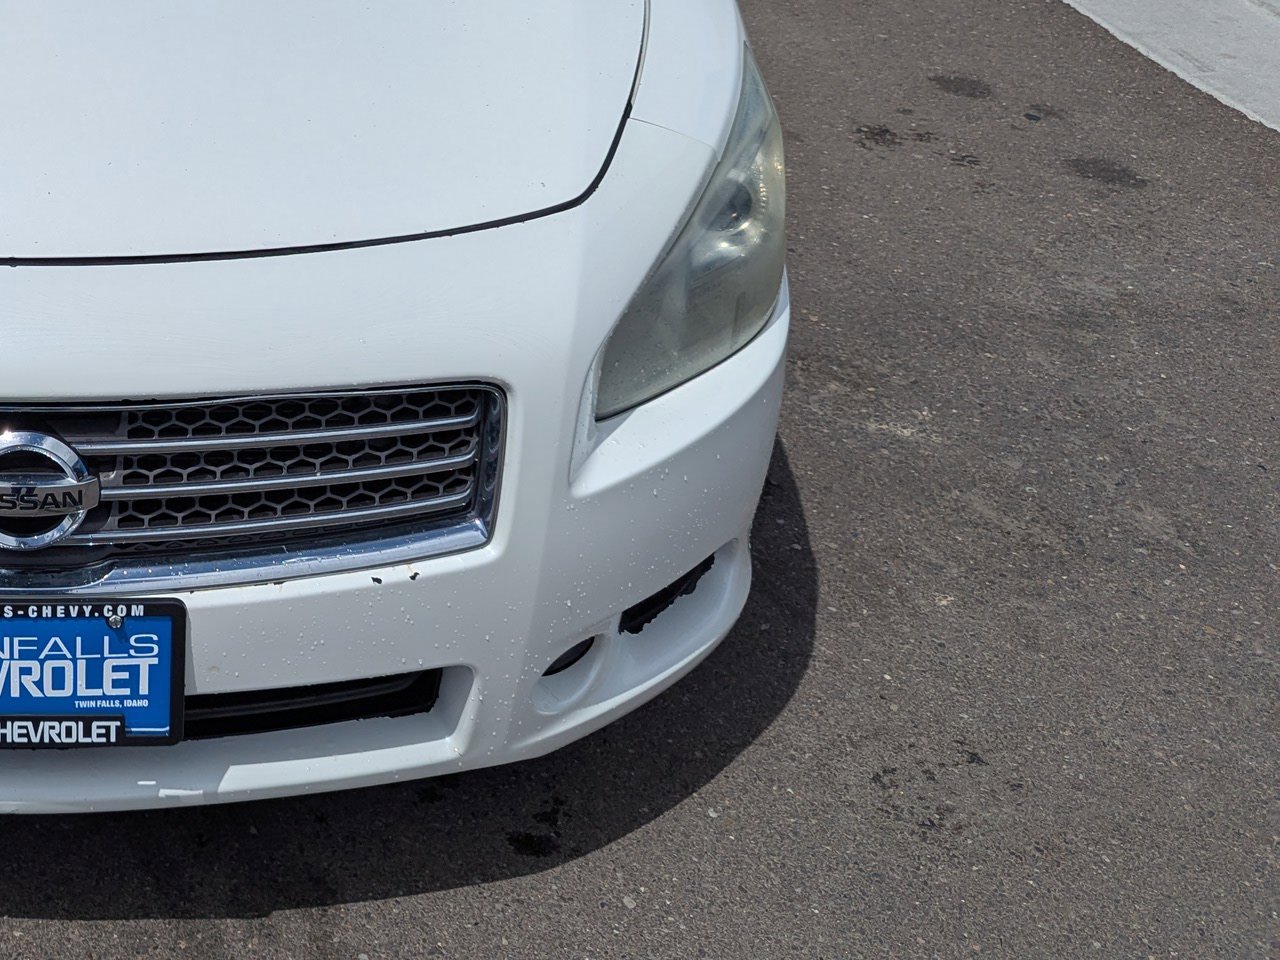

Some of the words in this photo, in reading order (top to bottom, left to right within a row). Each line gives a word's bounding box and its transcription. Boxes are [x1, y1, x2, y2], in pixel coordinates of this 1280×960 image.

[75, 700, 96, 708] TWIN
[97, 700, 122, 708] FALLS,
[124, 699, 149, 708] IDAHO
